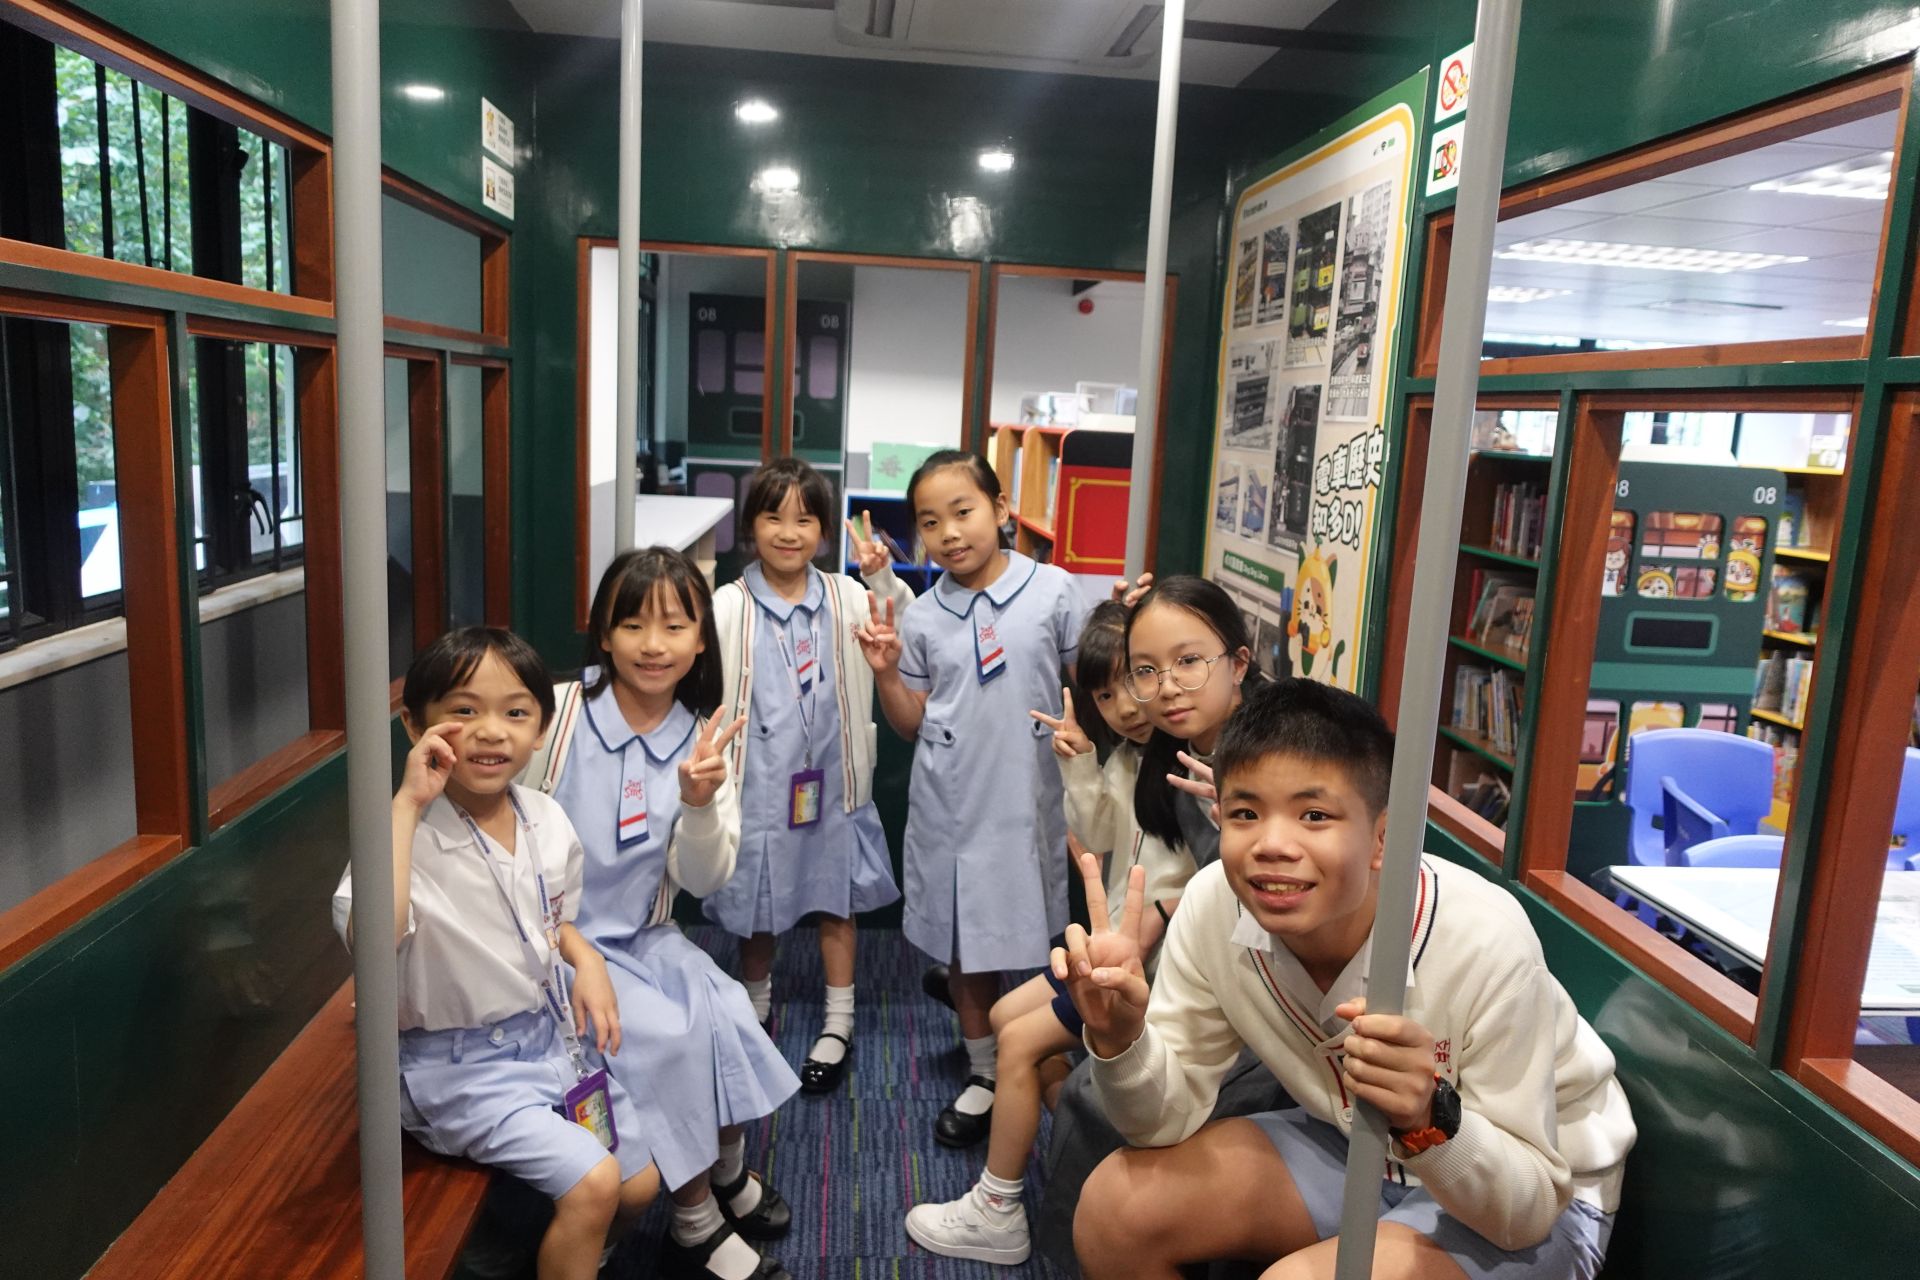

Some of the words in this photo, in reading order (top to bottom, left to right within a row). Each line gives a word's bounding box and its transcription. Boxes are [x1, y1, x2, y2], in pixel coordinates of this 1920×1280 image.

[697, 308, 717, 322] 08
[820, 315, 840, 329] 08
[1315, 424, 1385, 497] 電車歷史
[1615, 479, 1630, 498] 8
[1753, 487, 1777, 505] 08
[1312, 496, 1364, 552] 知多D!
